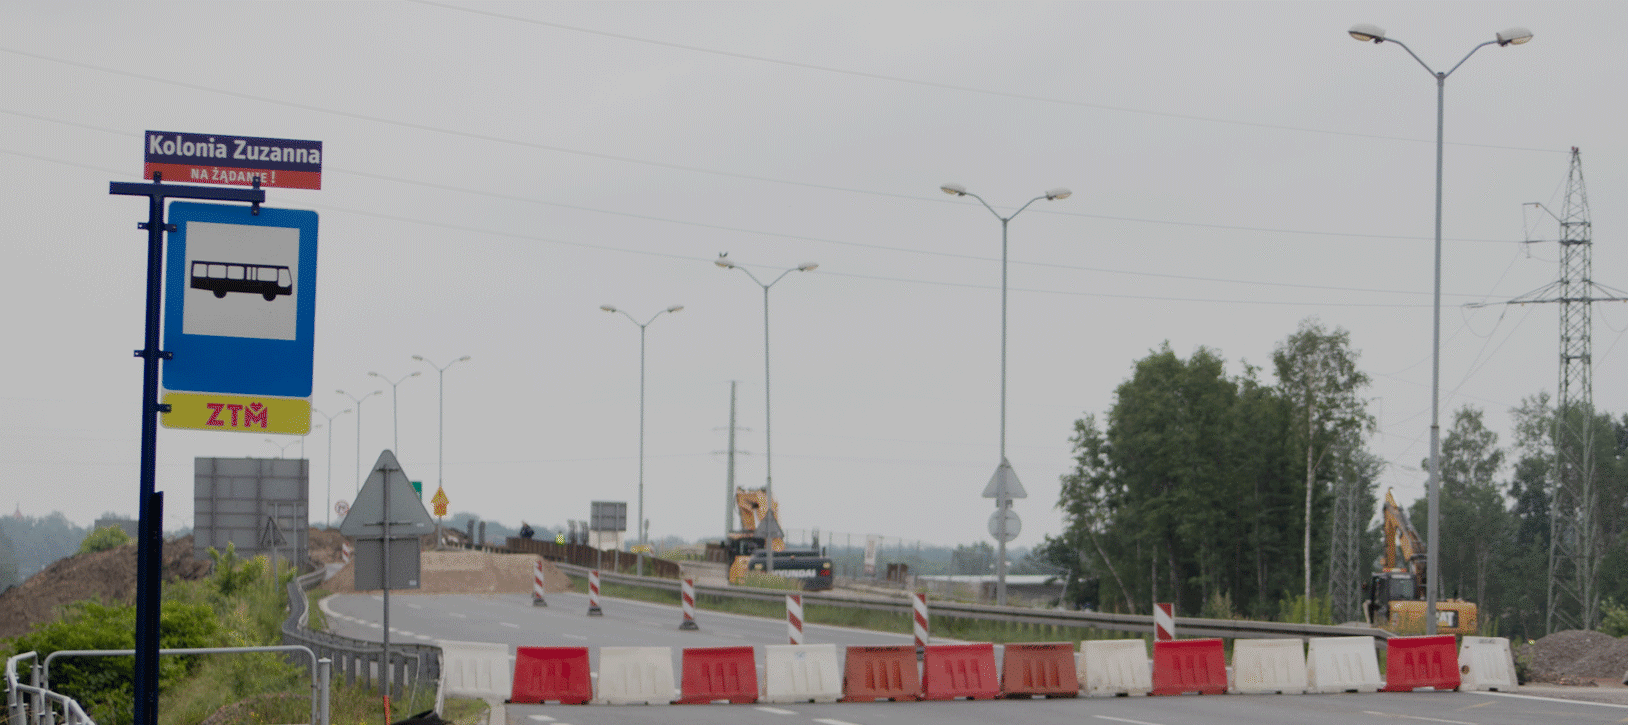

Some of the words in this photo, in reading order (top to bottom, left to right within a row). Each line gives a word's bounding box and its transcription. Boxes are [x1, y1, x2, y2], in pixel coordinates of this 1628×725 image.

[149, 134, 227, 159] Kolonia
[233, 139, 320, 164] Zuzanna
[191, 168, 208, 180] NA
[205, 401, 268, 429] ZTM
